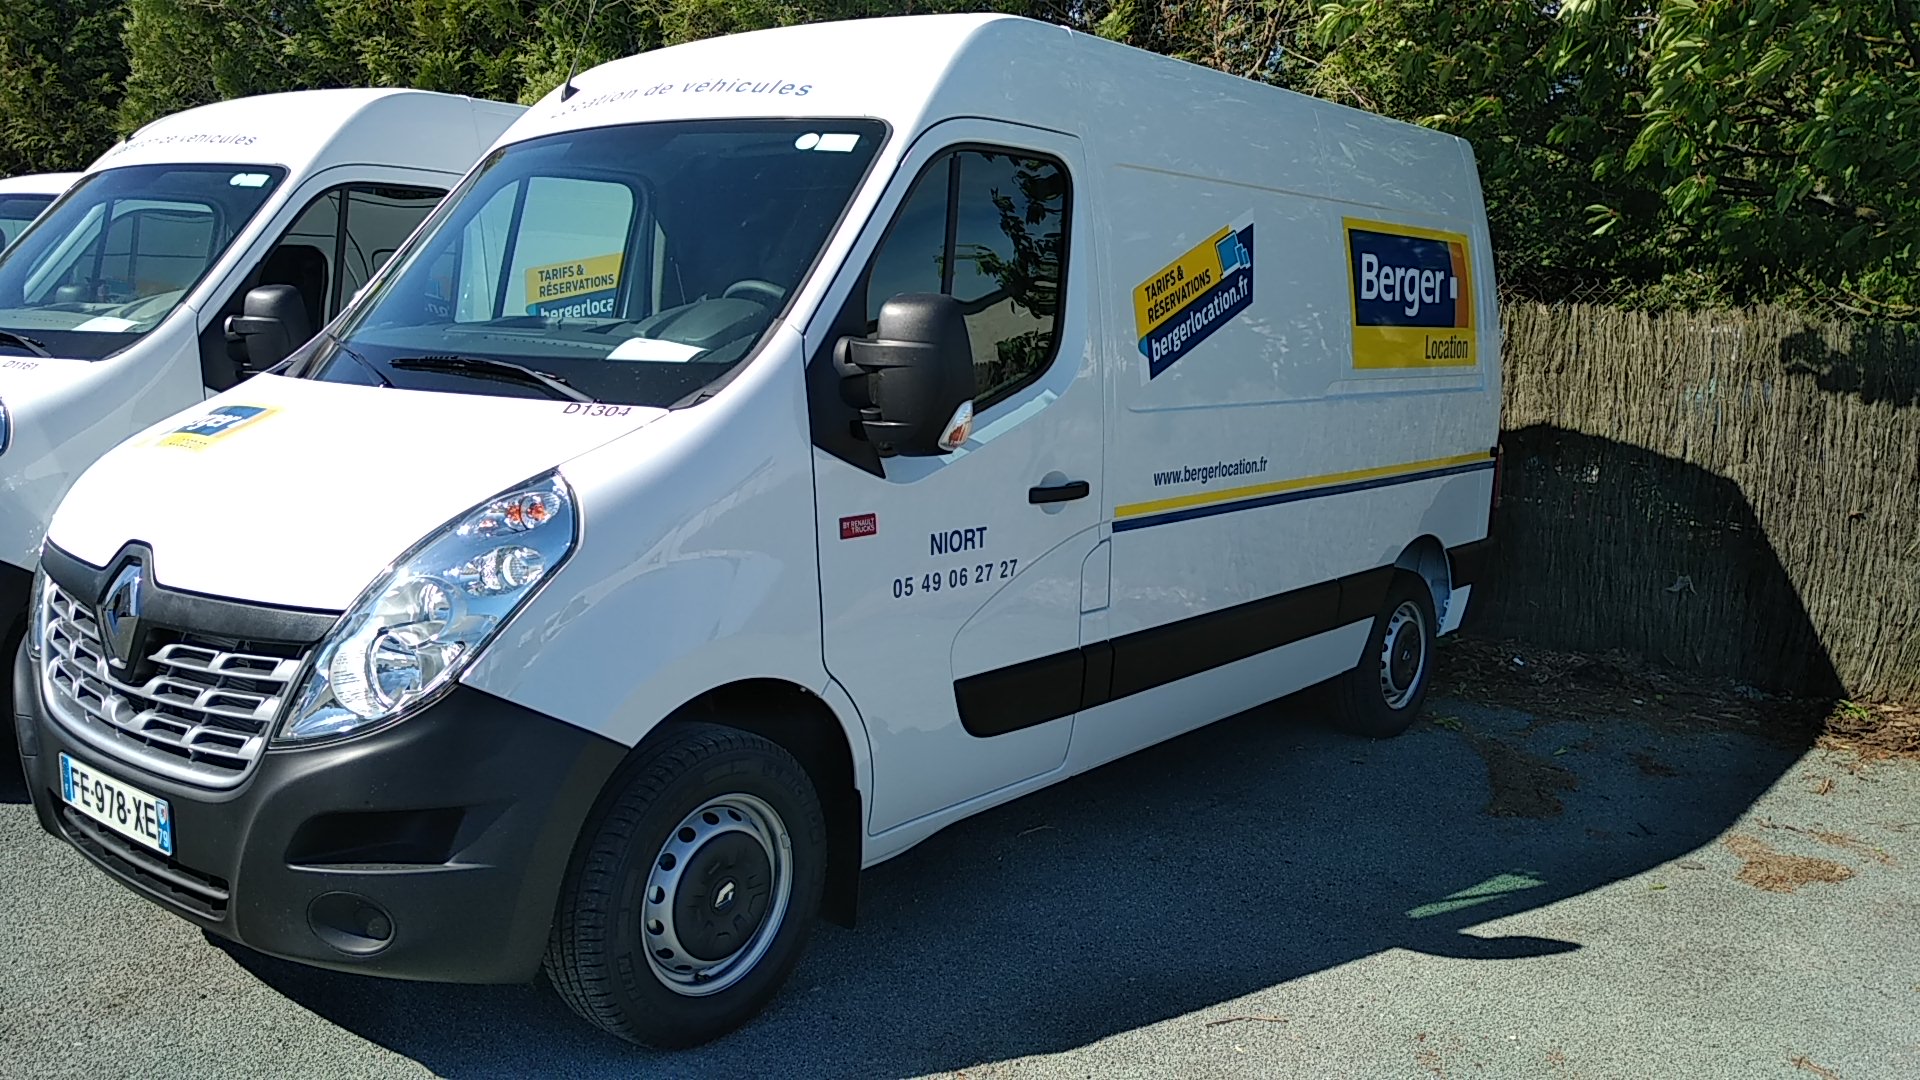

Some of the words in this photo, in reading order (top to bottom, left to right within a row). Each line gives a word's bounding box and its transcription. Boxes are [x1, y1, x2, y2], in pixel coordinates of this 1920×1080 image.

[643, 82, 674, 97] de
[538, 266, 574, 282] TARIFS
[576, 264, 584, 276] &
[539, 273, 615, 298] RÉSERVATIONS
[1144, 270, 1176, 302] TARIFS
[1177, 265, 1185, 281] &
[1361, 252, 1445, 317] Berger
[1147, 268, 1212, 325] RÉSERVATIONS
[1151, 274, 1249, 363] bergerlocation.fr
[1425, 334, 1469, 360] Location
[563, 402, 632, 417] D1304
[1153, 456, 1268, 487] www.bergerlocation.fr
[851, 517, 874, 527] RENAULT
[851, 525, 875, 535] TRUCKS
[930, 526, 987, 556] NIORT
[893, 577, 914, 599] 05
[921, 572, 941, 593] 49
[949, 567, 968, 588] 06
[975, 563, 994, 584] 27
[999, 559, 1018, 579] 27
